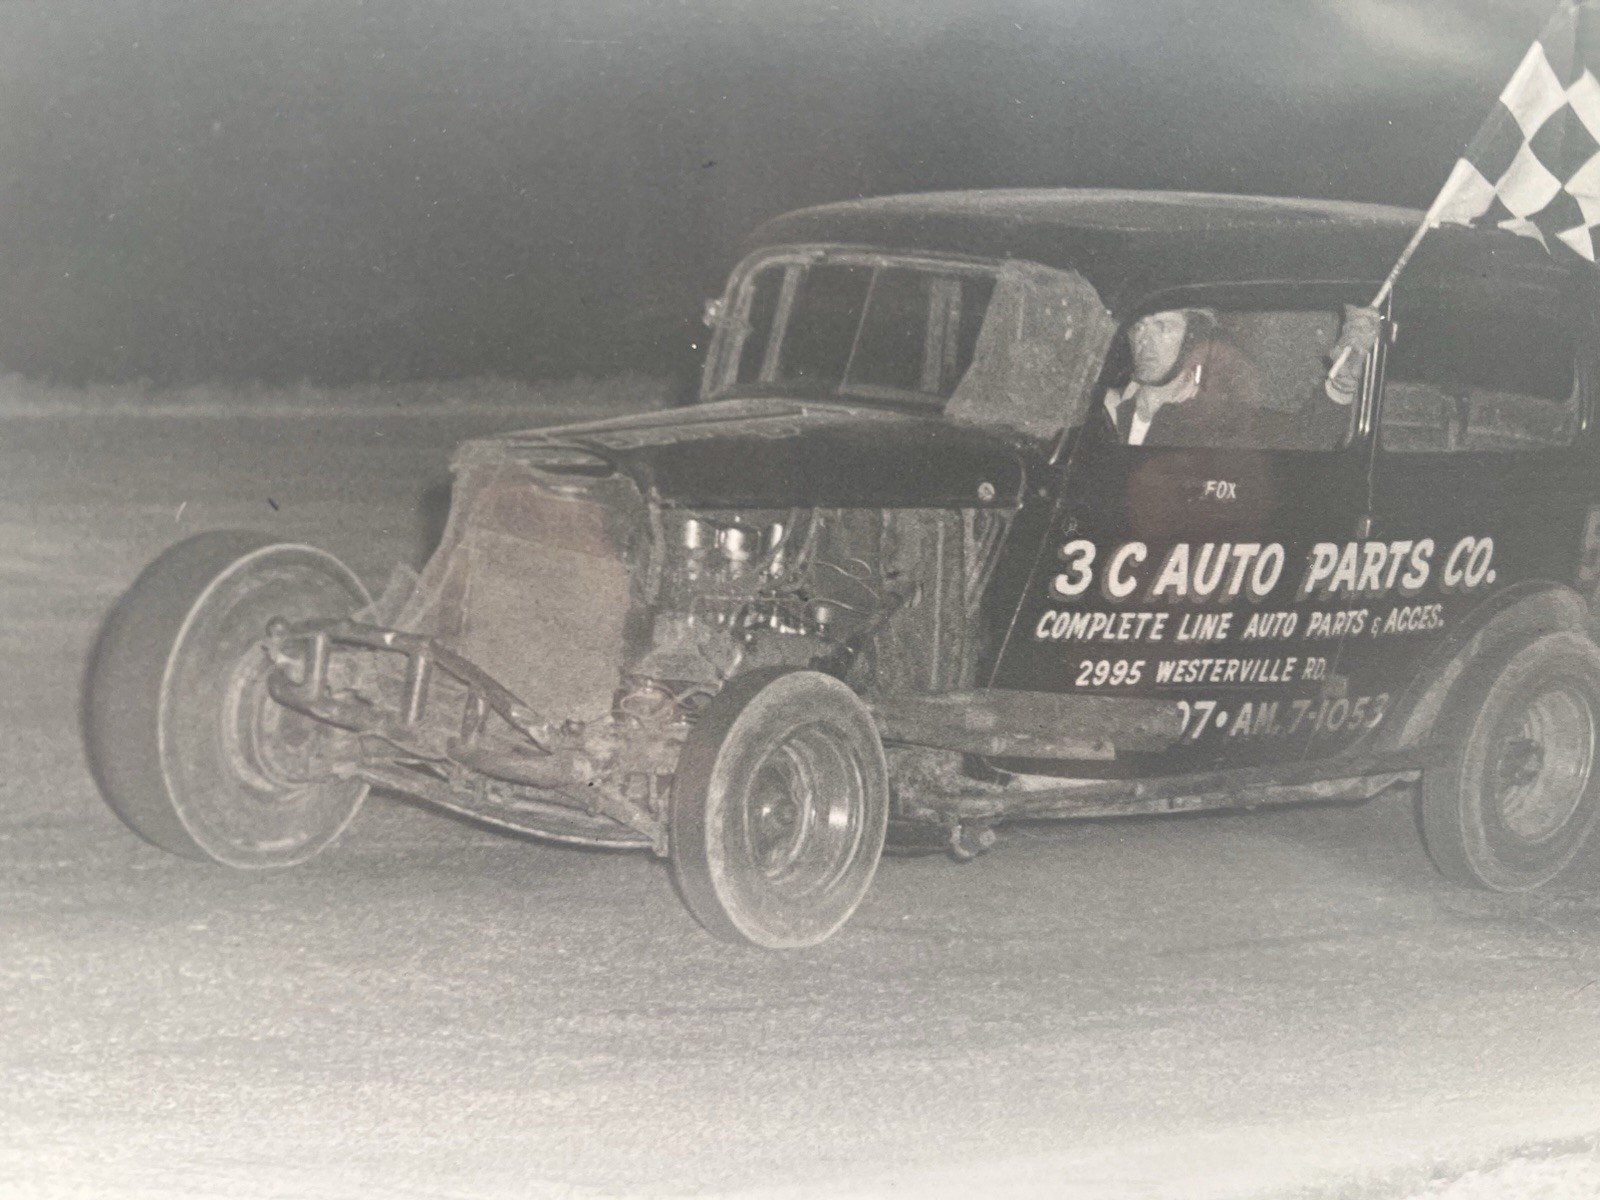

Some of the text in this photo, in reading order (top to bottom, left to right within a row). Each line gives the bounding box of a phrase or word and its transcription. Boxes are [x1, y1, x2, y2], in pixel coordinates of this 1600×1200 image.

[1204, 480, 1236, 499] FOX
[1055, 536, 1497, 597] 3 C AUTO PARTS CO.
[1036, 610, 1168, 640] COMPLETE
[1176, 612, 1233, 640] LINE
[1243, 611, 1298, 639] AUTO
[1306, 609, 1369, 637] PARTS
[1384, 604, 1445, 634] ACCES.
[1075, 660, 1146, 687] 2995
[1155, 657, 1298, 683] WESTERVILLE
